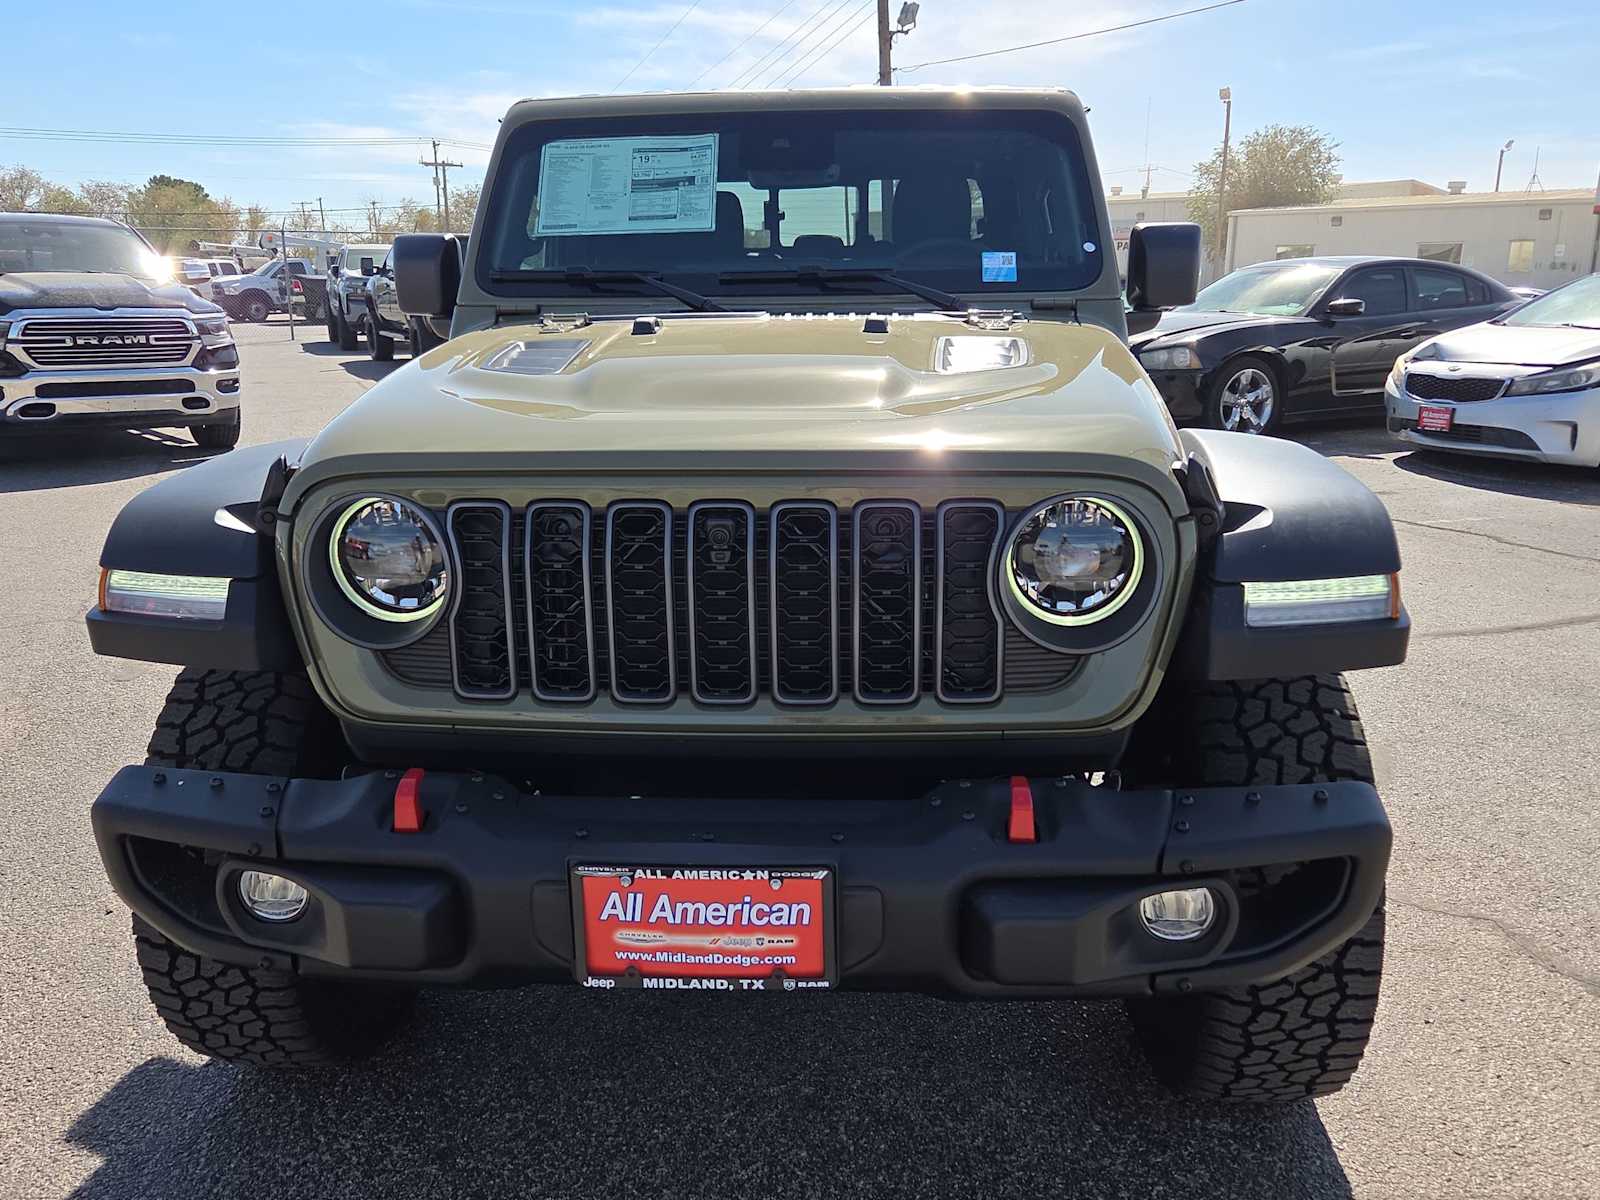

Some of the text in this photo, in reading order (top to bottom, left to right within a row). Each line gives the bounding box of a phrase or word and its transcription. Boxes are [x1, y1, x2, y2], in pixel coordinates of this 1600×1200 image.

[639, 155, 650, 163] 19
[77, 335, 146, 345] RAM
[634, 869, 667, 879] ALL
[599, 891, 811, 926] All American
[723, 937, 752, 947] Jeep
[615, 951, 796, 966] www.MidlandDodge.com
[583, 976, 615, 989] Jeep
[642, 977, 765, 990] MIDLAND, TX
[797, 980, 829, 988] RAM
